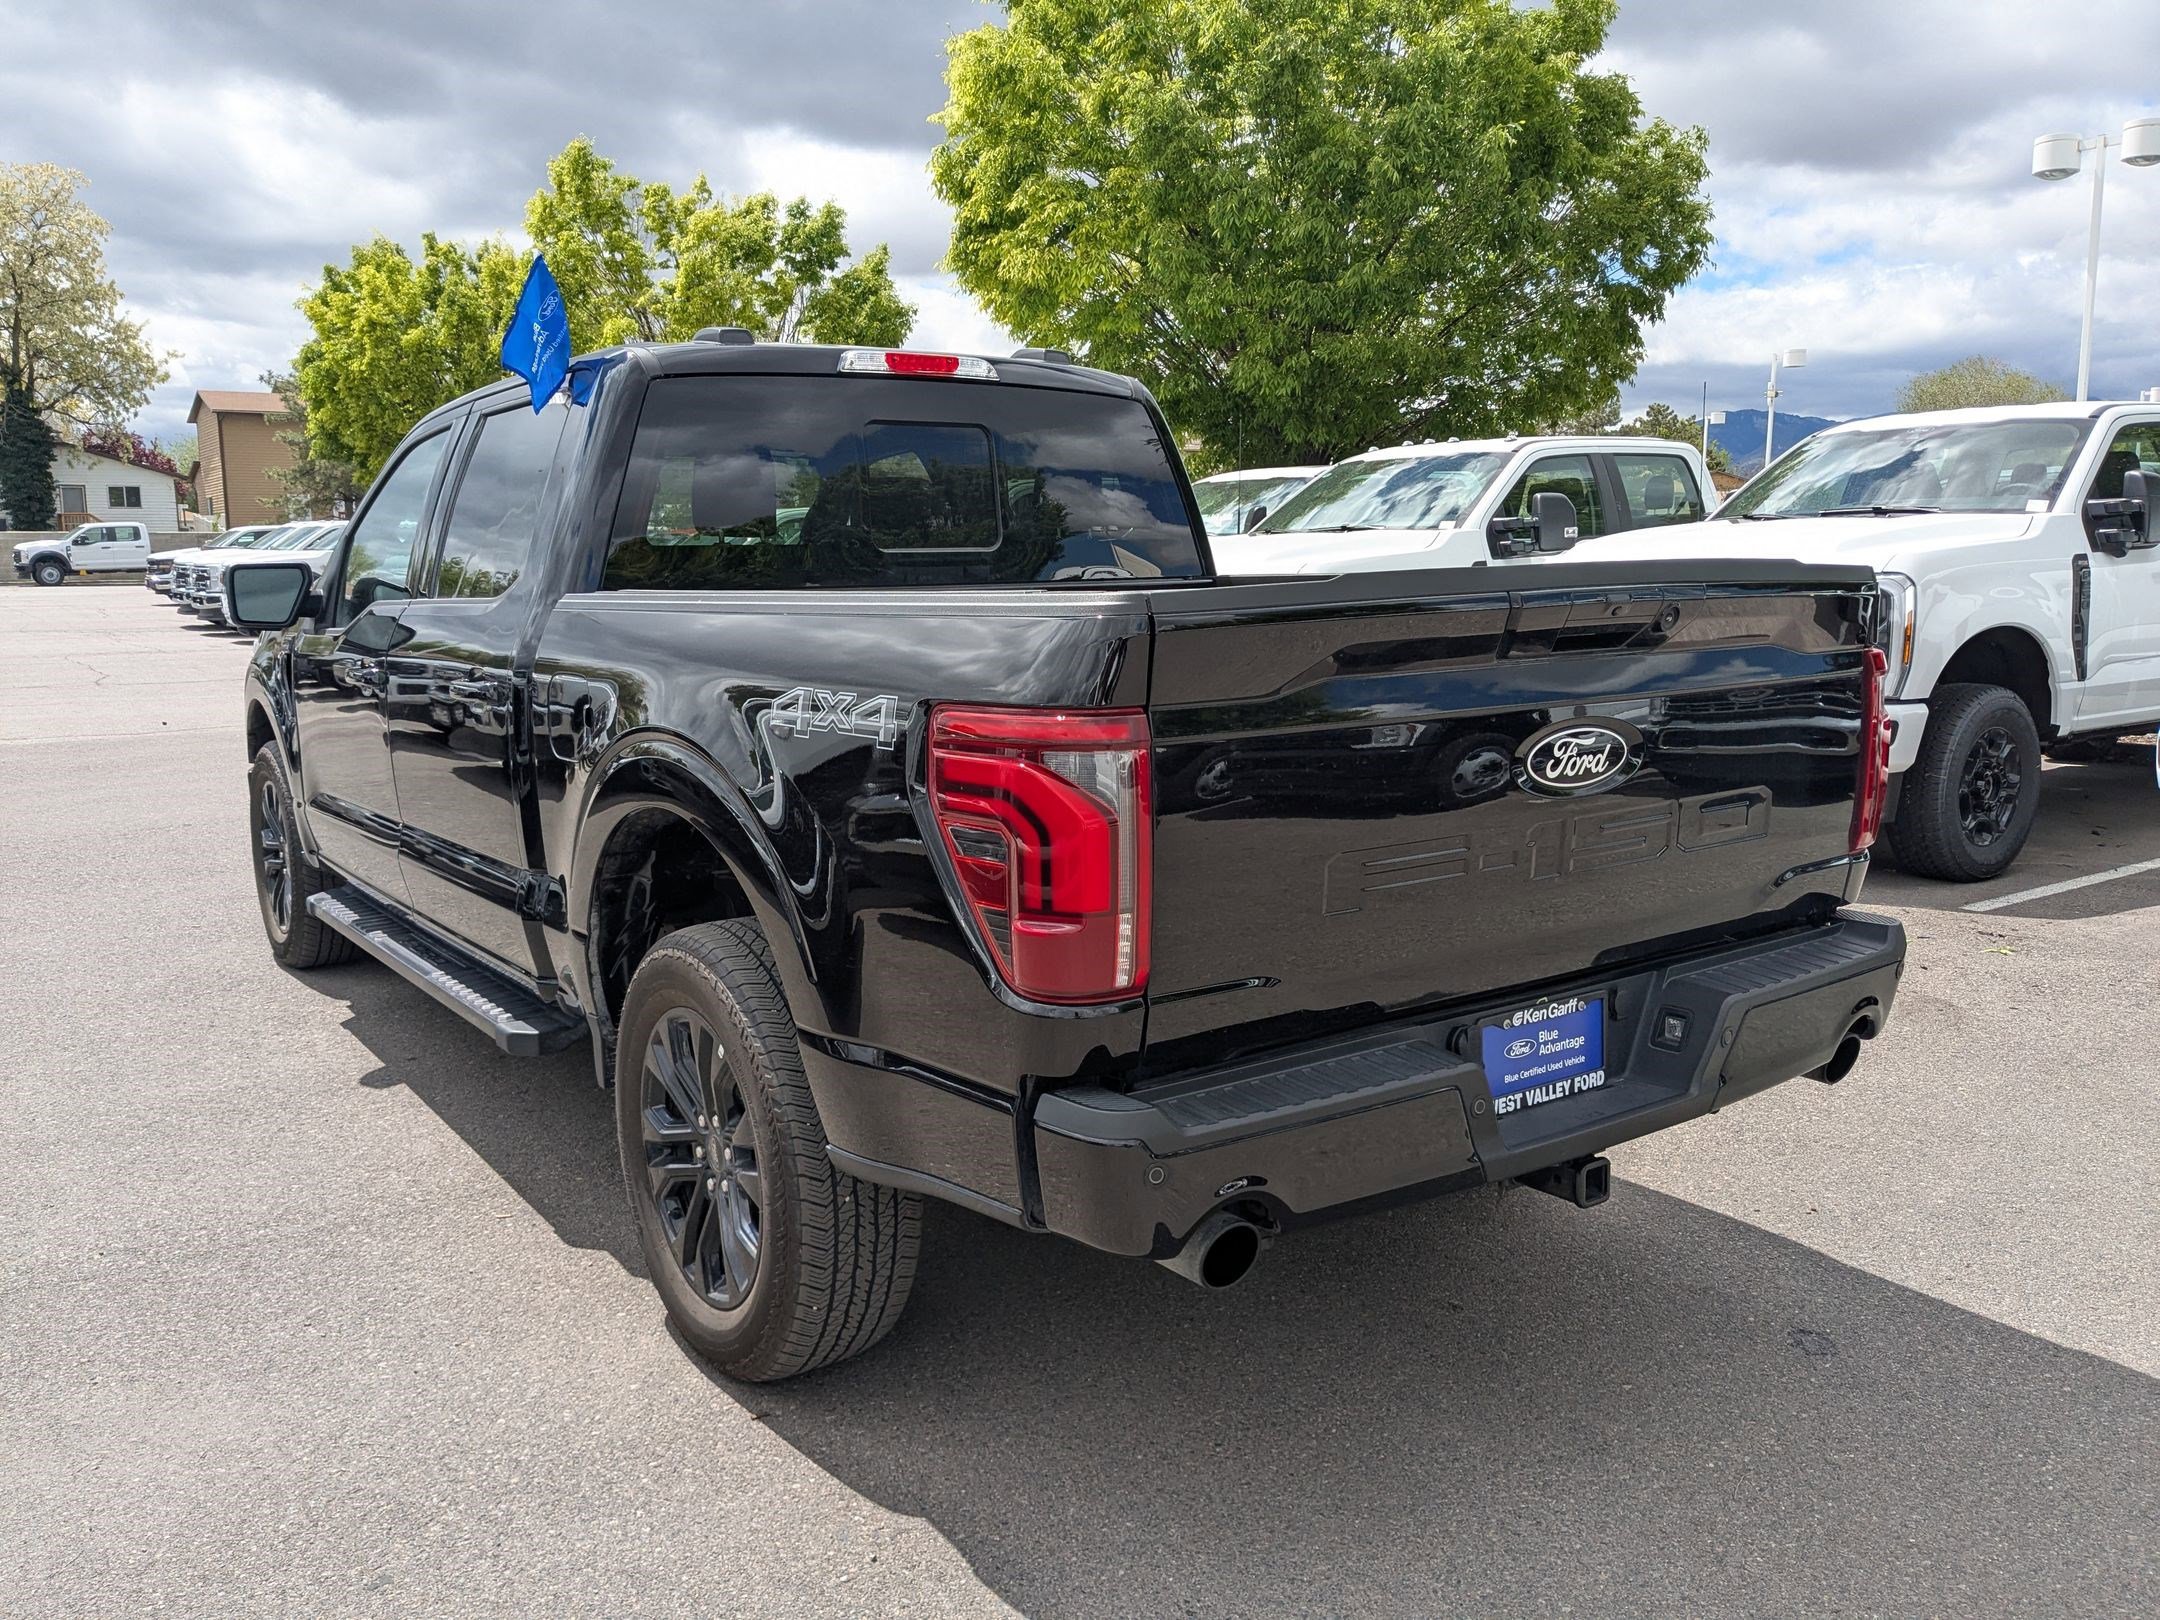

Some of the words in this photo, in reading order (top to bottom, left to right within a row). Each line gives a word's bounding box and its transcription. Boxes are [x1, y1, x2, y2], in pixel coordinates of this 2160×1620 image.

[1546, 735, 1612, 780] Ford
[1323, 785, 1773, 917] F-150
[1523, 1008, 1547, 1025] Ken
[1548, 998, 1578, 1018] Garff
[1538, 1029, 1559, 1042] Blue
[1538, 1035, 1585, 1056] Advantage
[1510, 1043, 1531, 1057] Ford
[1504, 1073, 1519, 1084] Blue
[1519, 1064, 1546, 1079] Certified
[1547, 1060, 1563, 1072] Used
[1564, 1054, 1586, 1067] Vehicle
[1525, 1079, 1572, 1107] VALLEY
[1573, 1070, 1605, 1093] FORD
